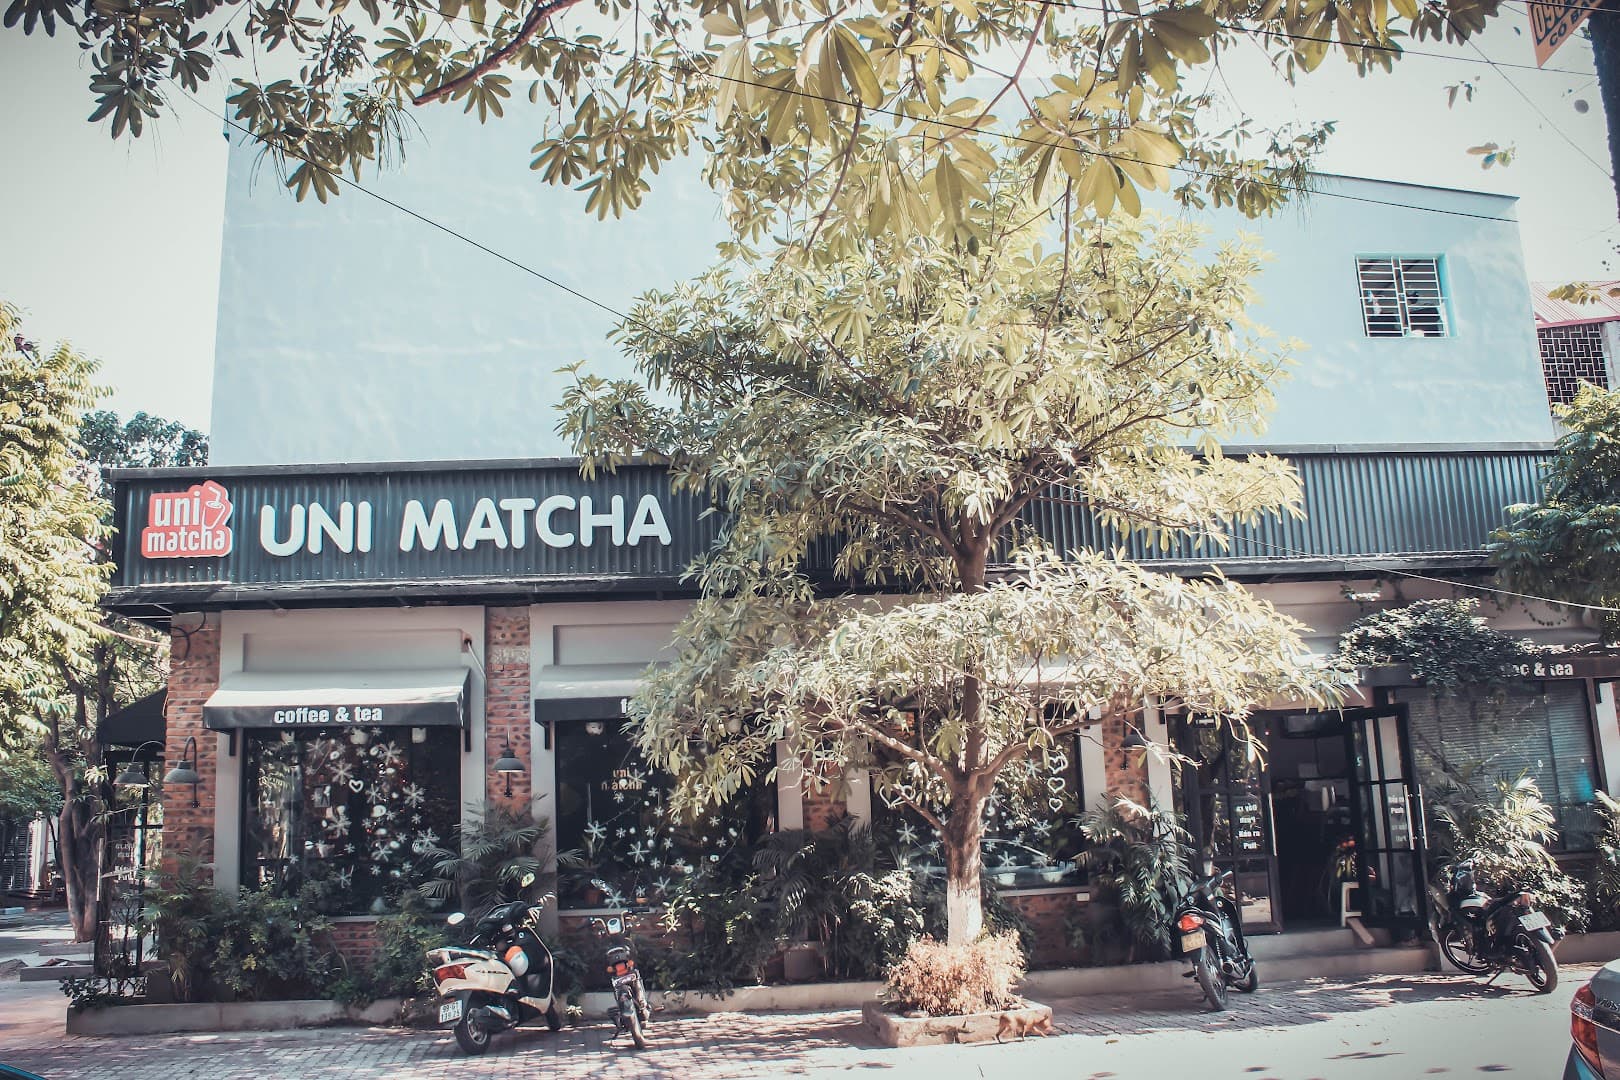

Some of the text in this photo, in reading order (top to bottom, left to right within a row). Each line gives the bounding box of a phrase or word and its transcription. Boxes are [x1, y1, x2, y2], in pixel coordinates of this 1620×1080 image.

[154, 490, 201, 527] uni
[147, 525, 226, 552] matcha
[259, 494, 672, 557] UNI MATCHA
[1533, 661, 1546, 677] &
[273, 706, 383, 724] coffee & tea
